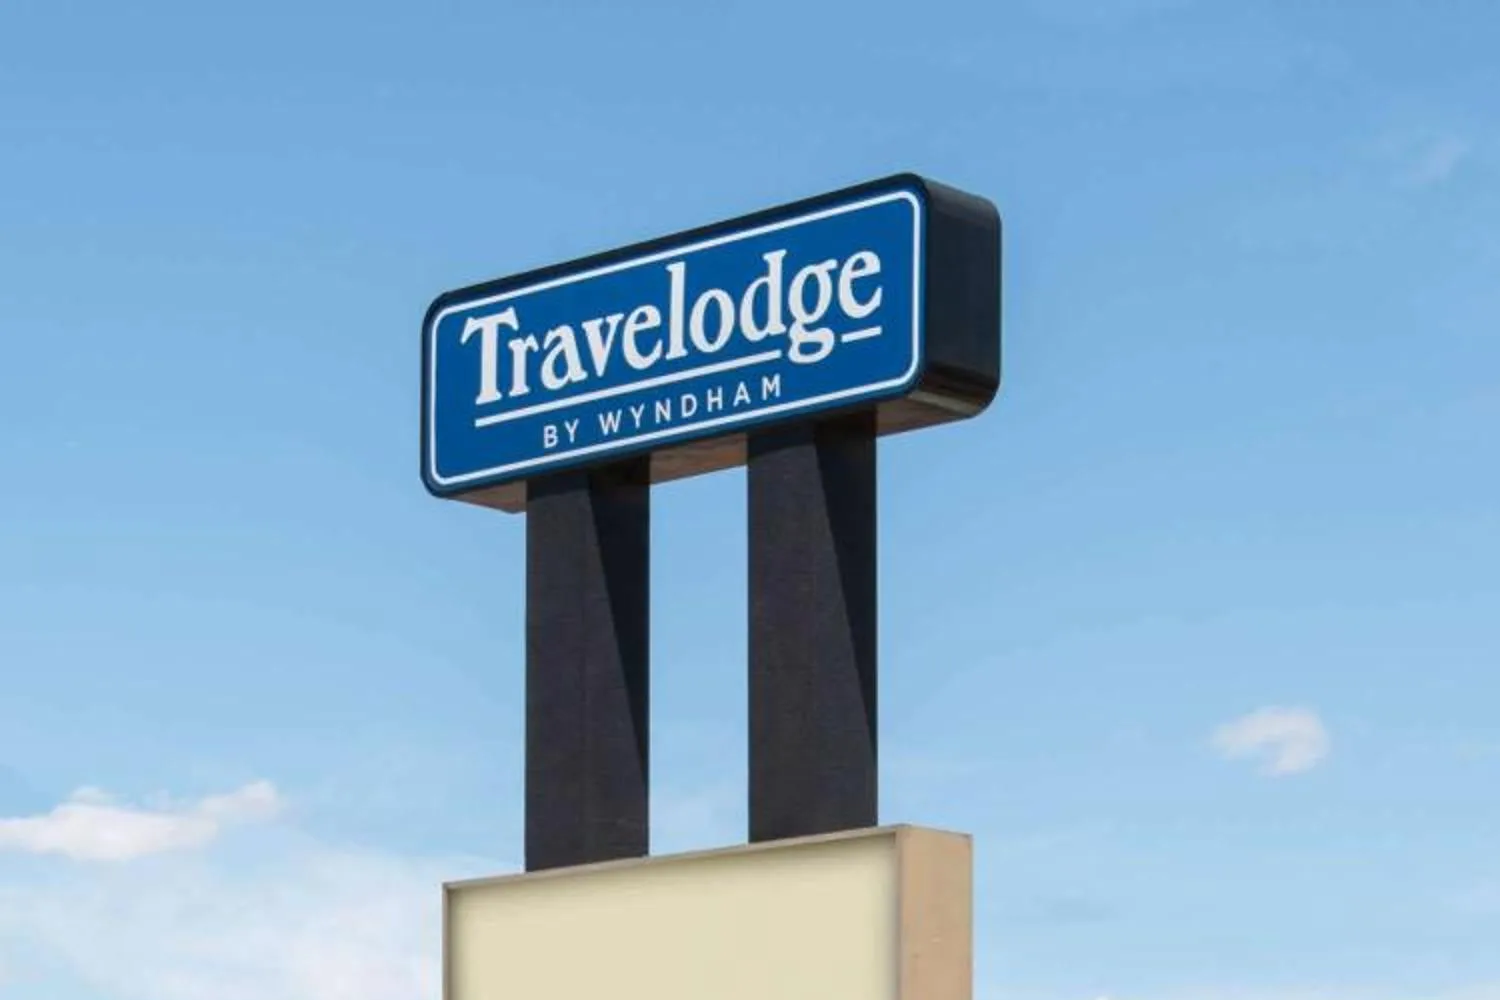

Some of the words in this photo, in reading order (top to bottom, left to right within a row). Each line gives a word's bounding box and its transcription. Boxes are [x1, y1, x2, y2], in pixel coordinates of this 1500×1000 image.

[460, 249, 883, 404] Travelodge
[543, 419, 581, 449] BY
[600, 373, 782, 435] WYNDHAM
